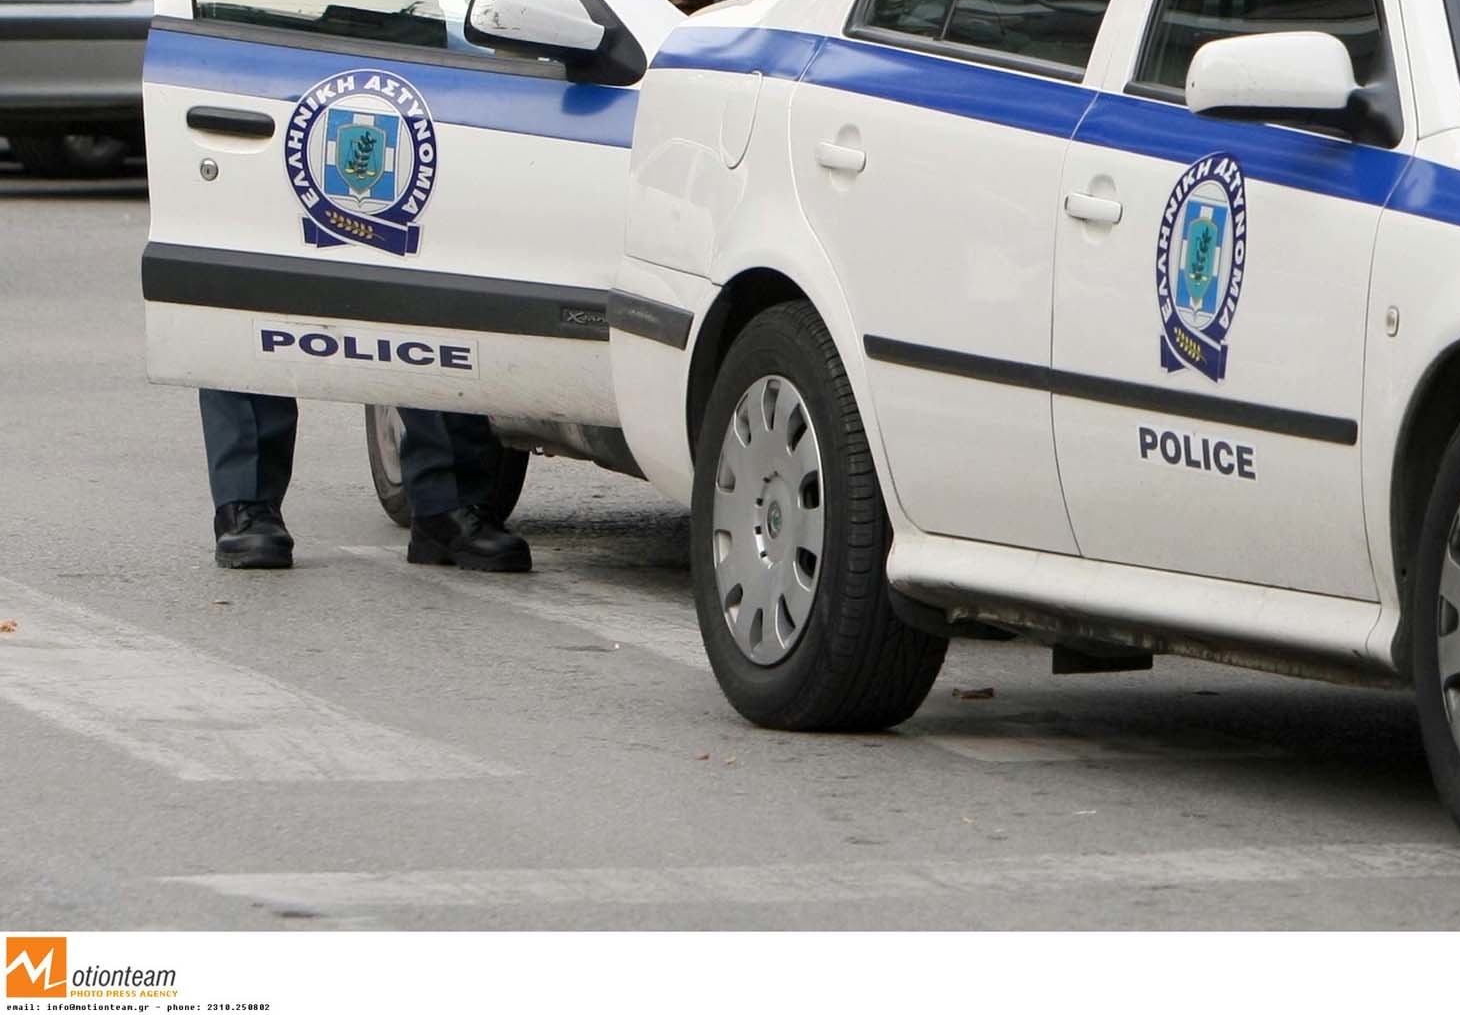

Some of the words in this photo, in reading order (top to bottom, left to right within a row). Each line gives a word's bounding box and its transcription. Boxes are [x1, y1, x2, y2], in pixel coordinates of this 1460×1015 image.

[287, 75, 356, 209] ΕΛΛΗΝΙΚΗ
[364, 75, 434, 215] ΑΣΤΥΝΟΜΙΑ
[1157, 158, 1213, 324] ΕΛΛΗΝΙΚΗ
[1213, 157, 1245, 331] ΑΣΤΥΝΟΜΙΑ
[260, 329, 473, 370] POLICE
[1138, 426, 1257, 481] POLICE
